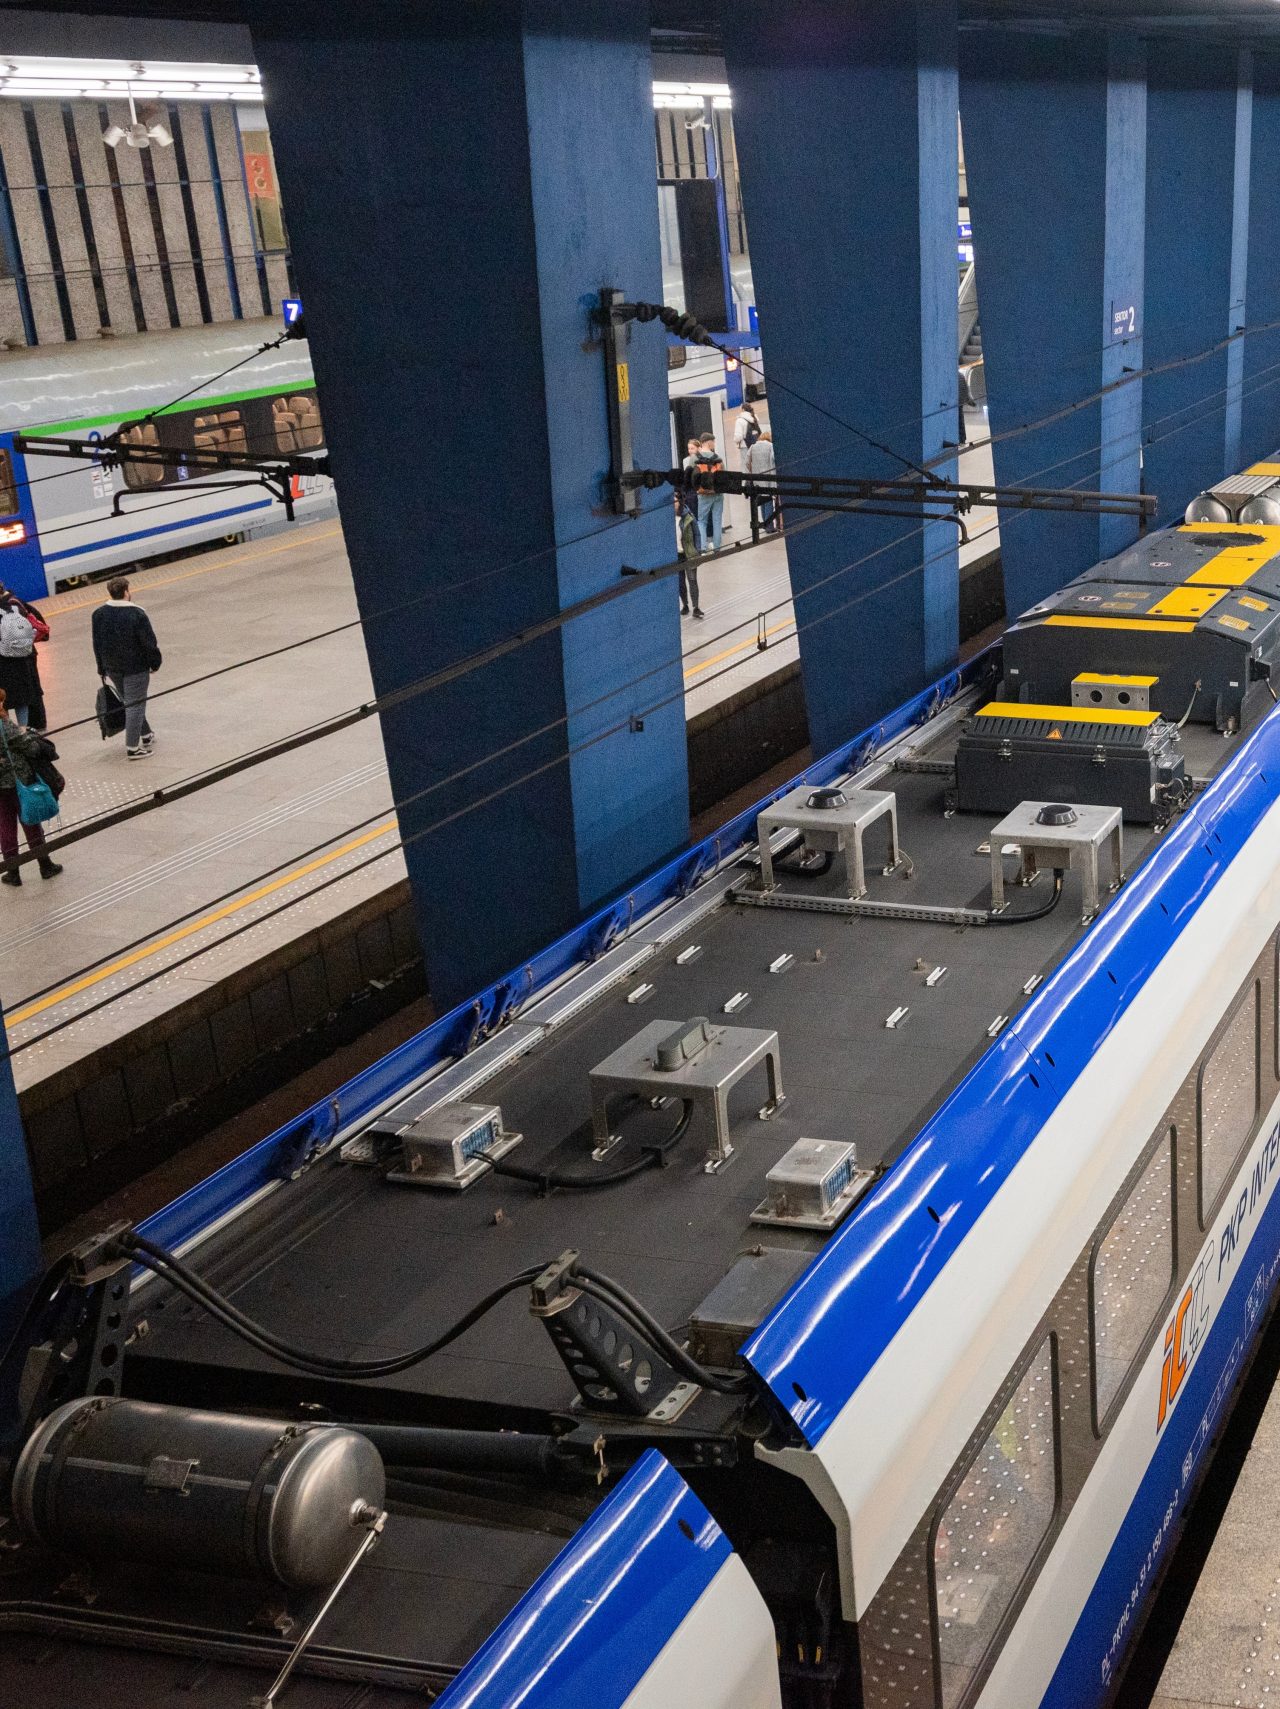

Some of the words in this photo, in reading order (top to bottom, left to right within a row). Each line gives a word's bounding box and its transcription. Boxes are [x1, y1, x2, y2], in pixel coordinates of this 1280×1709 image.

[286, 303, 299, 321] 7
[1128, 306, 1135, 332] 2
[1217, 1186, 1248, 1284] PKP
